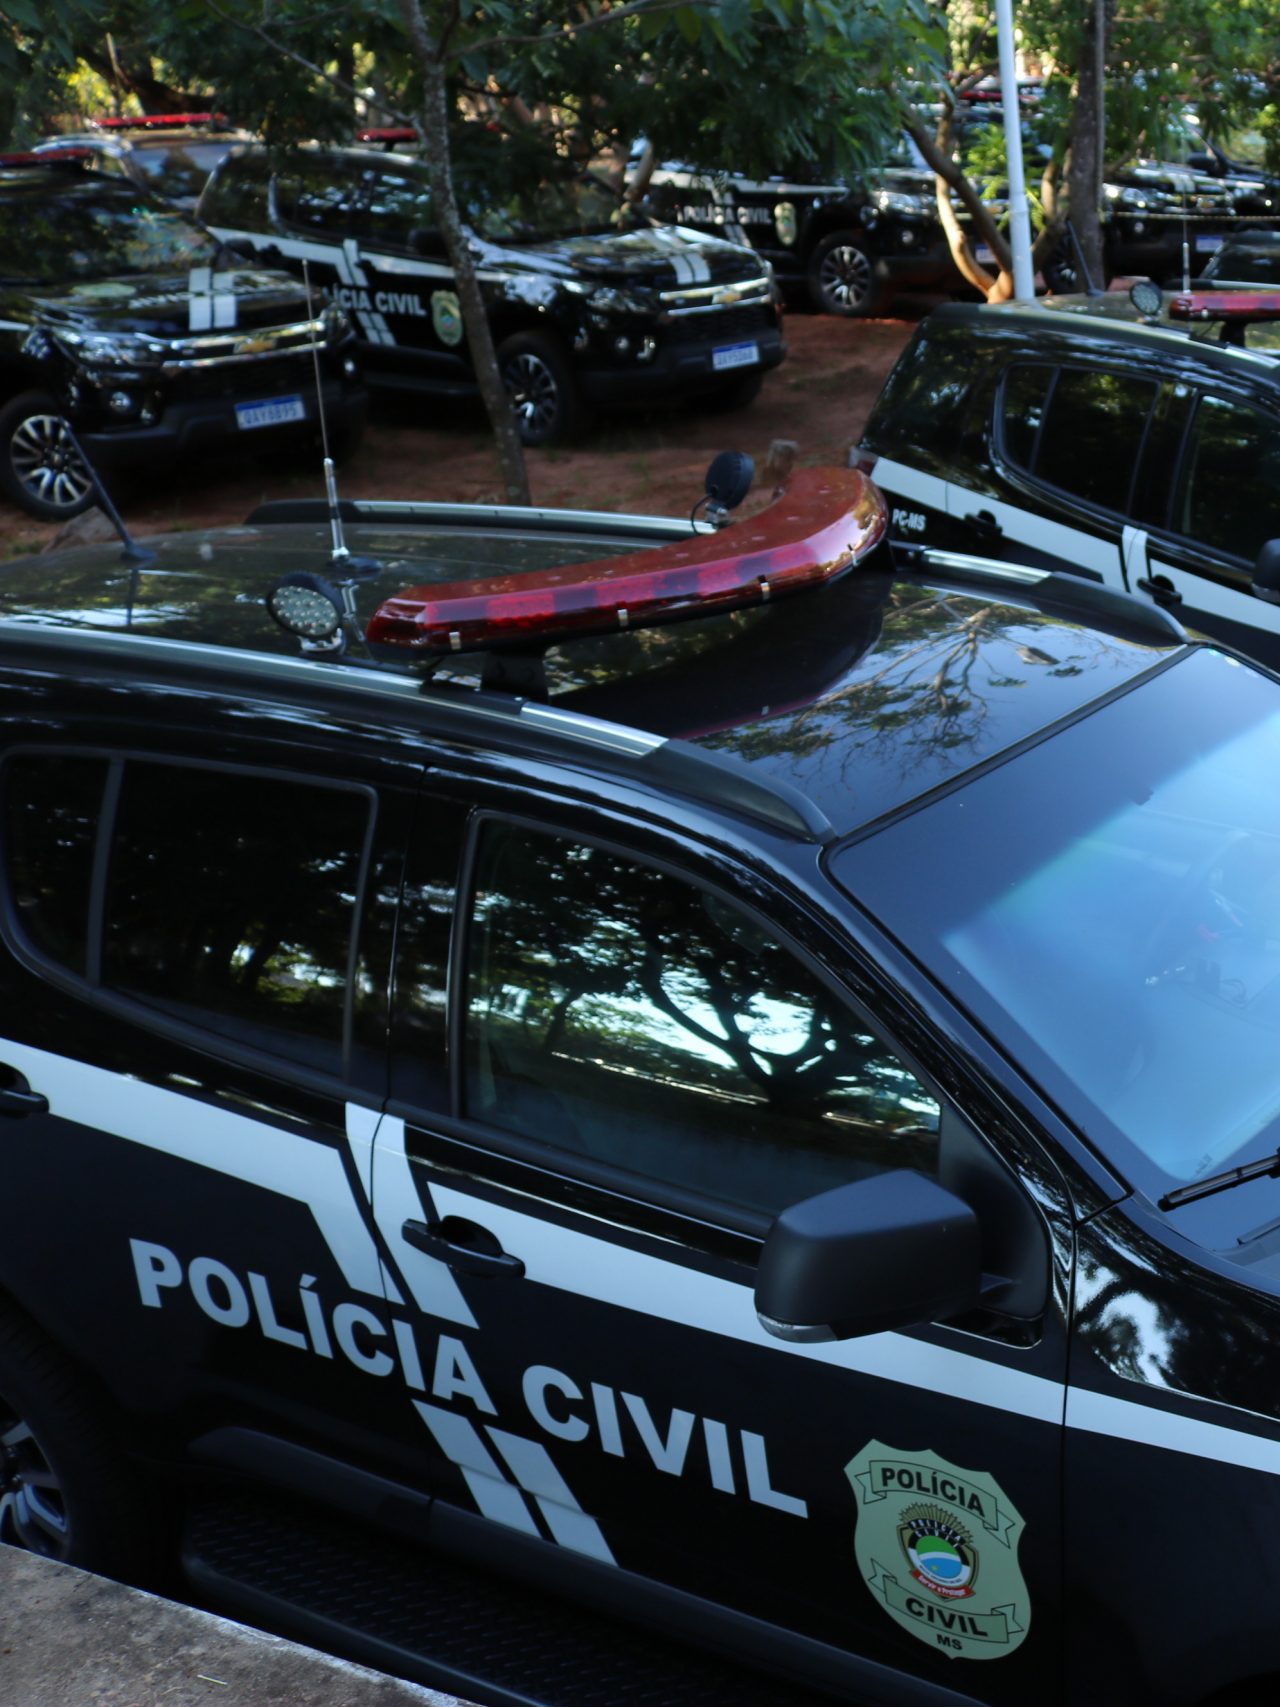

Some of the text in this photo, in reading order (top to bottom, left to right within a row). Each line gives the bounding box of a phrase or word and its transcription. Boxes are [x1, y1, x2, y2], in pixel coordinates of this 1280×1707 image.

[375, 291, 428, 317] CIVIL
[891, 508, 927, 532] PC-MS
[129, 1238, 809, 1519] POLÍCIA CIVIL
[881, 1466, 986, 1518] POLÍCIA
[905, 1597, 989, 1638] CIVIL
[936, 1633, 963, 1651] MS
